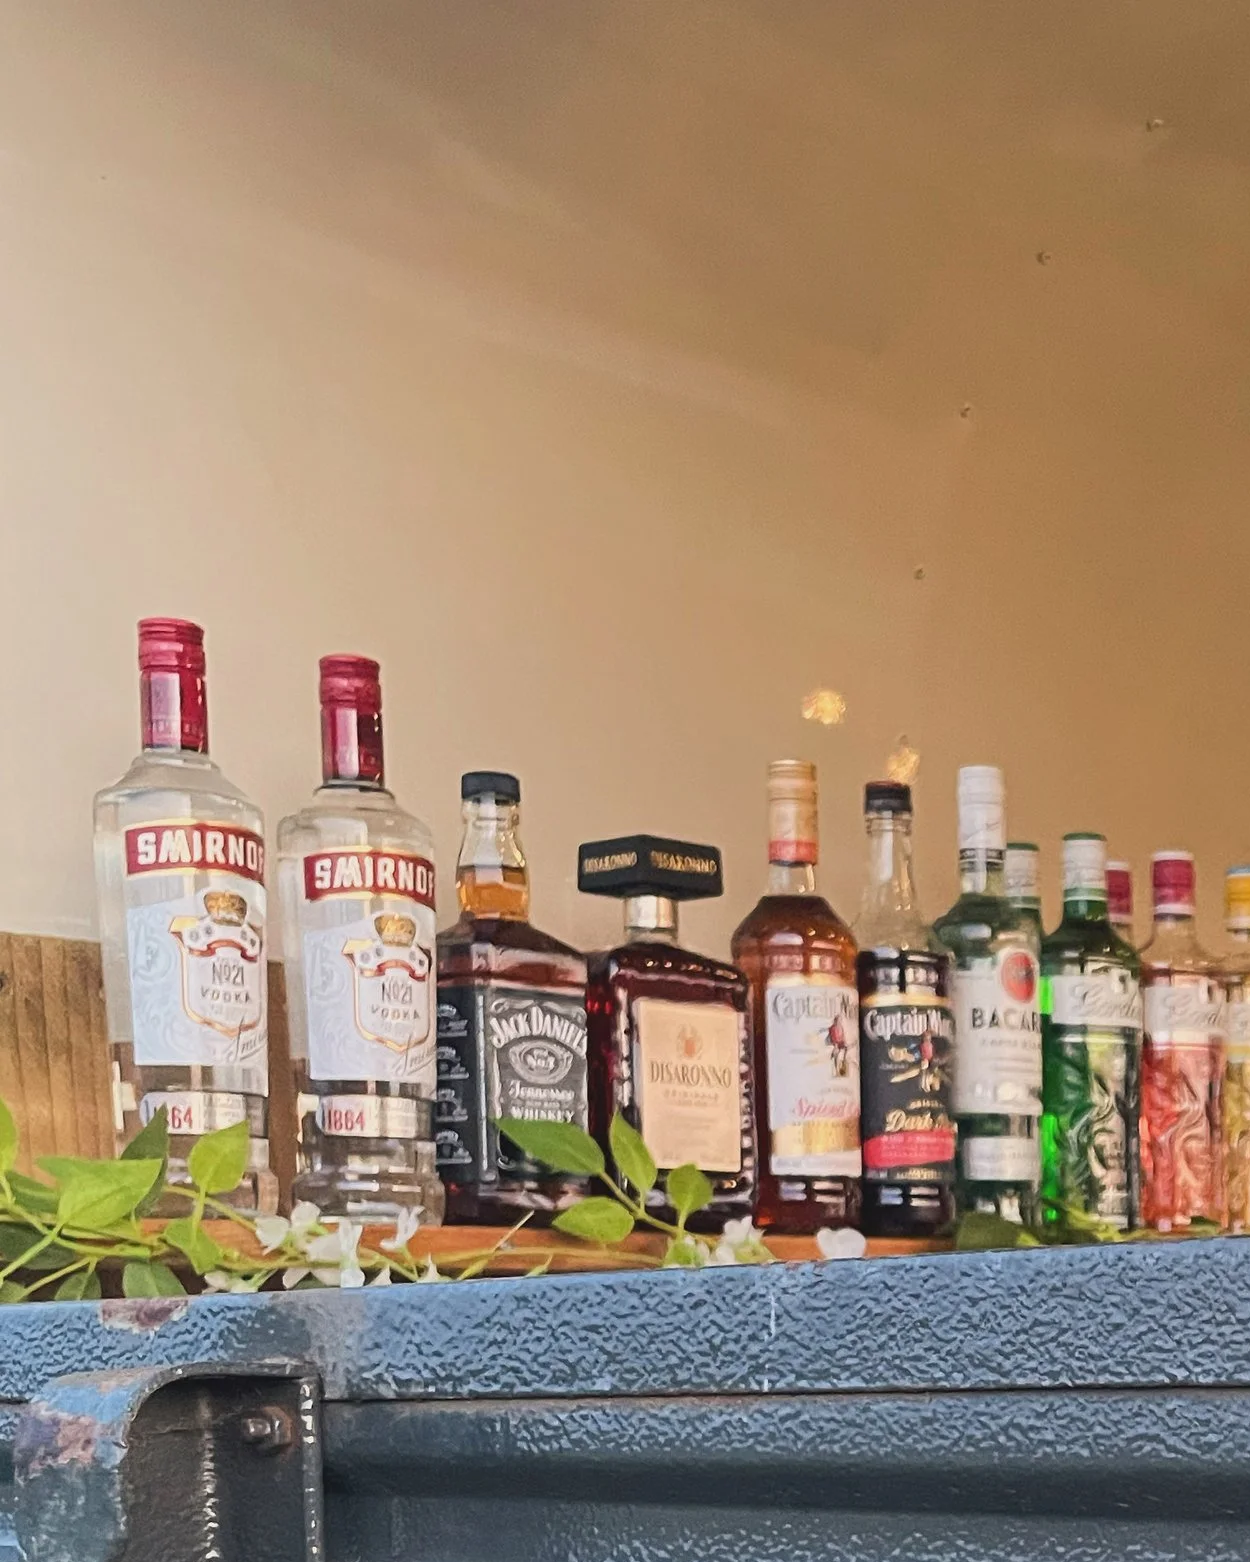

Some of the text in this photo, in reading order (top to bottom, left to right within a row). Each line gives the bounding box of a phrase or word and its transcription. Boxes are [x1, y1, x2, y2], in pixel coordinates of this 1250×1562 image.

[200, 987, 252, 1004] VODKA
[772, 991, 837, 1024] Captain
[370, 1004, 420, 1020] VODKA
[864, 1007, 928, 1041] Captain
[650, 1061, 732, 1088] DISARONNO
[327, 1108, 366, 1132] 1864
[885, 1109, 933, 1132] Dark
